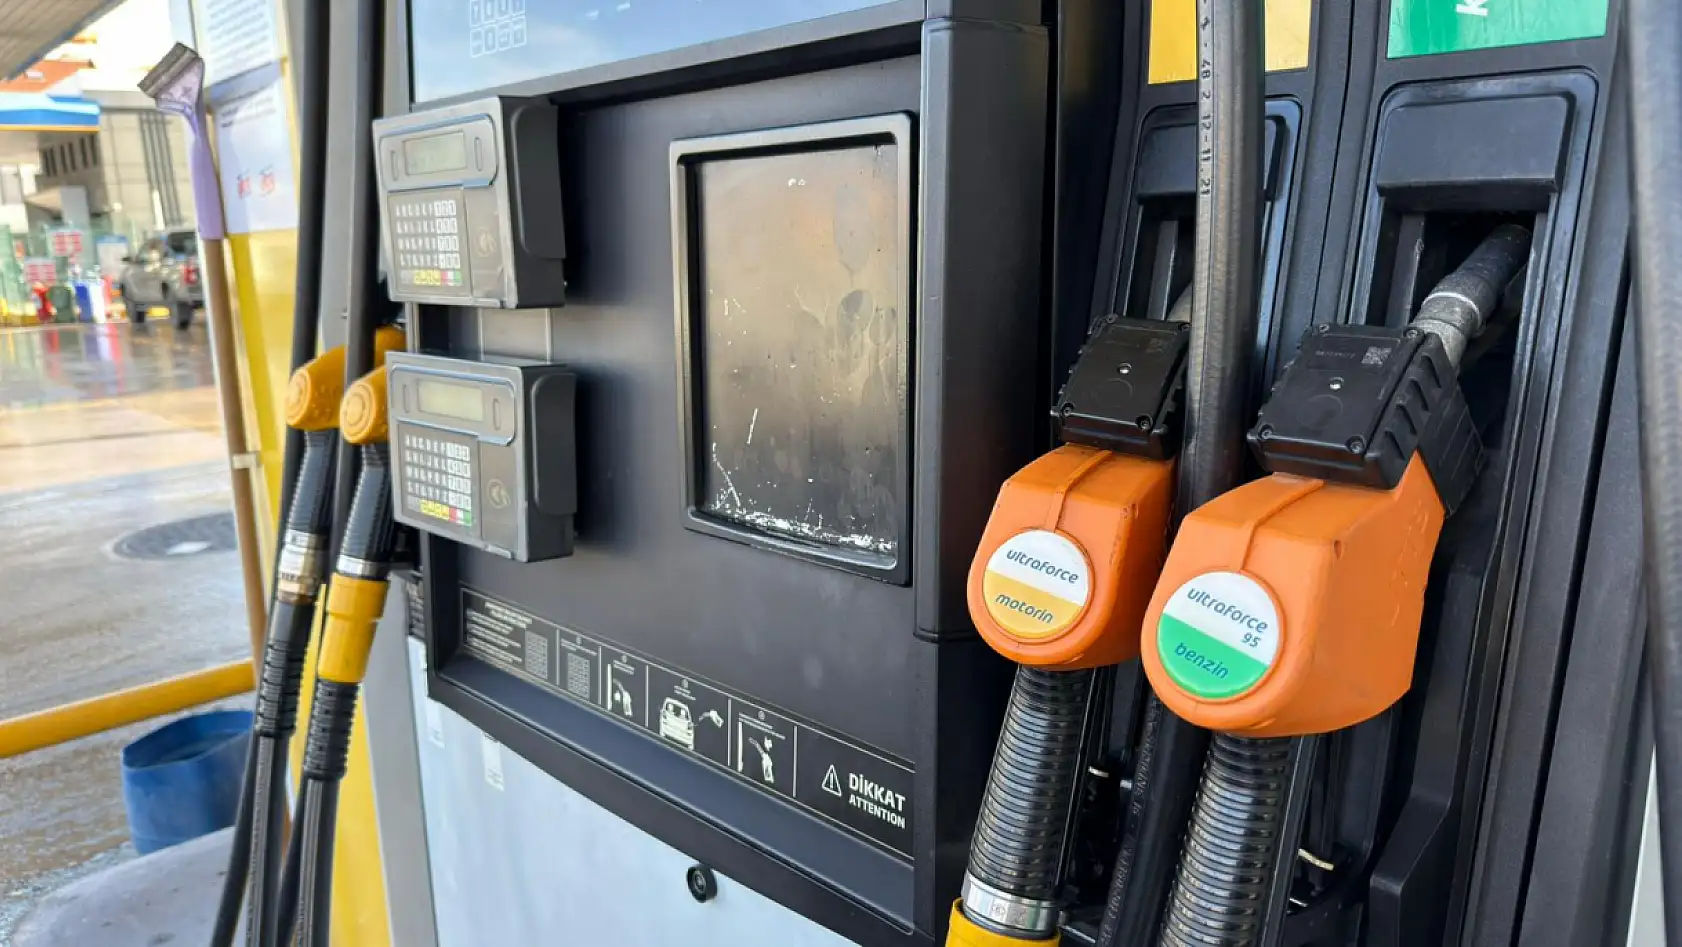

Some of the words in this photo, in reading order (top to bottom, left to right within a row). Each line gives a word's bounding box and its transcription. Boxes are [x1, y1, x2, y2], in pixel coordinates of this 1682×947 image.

[1006, 548, 1079, 584] ultraforce
[995, 593, 1054, 625] motorin
[1188, 587, 1268, 634] ultraforce
[1242, 632, 1262, 648] 95
[1174, 641, 1229, 680] benzin
[848, 772, 906, 812] DİKKAT
[848, 794, 906, 829] ATTENTION
